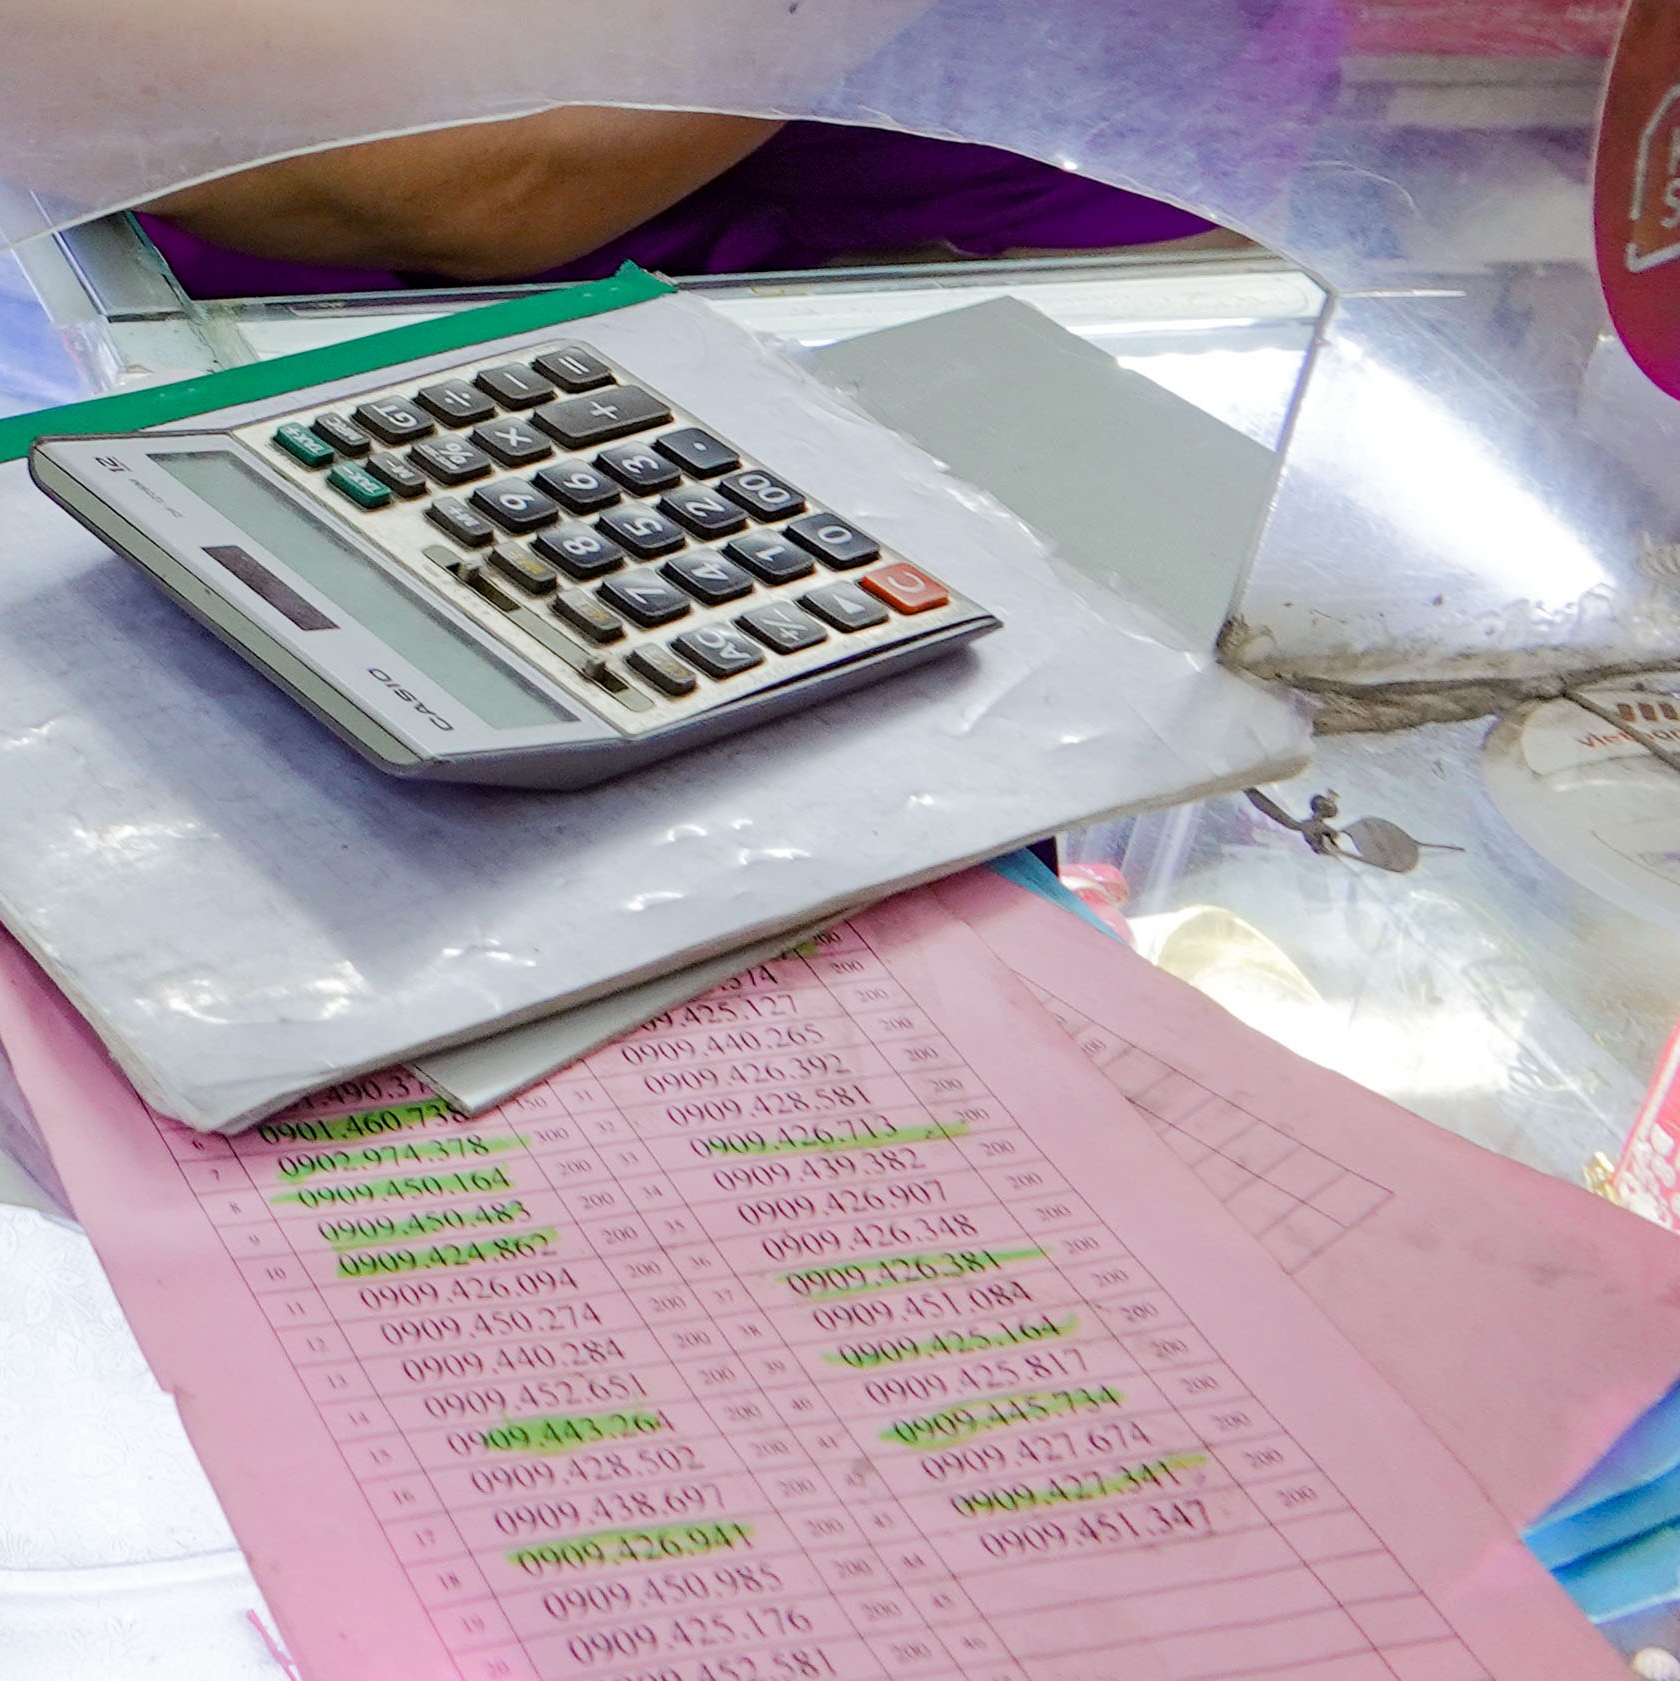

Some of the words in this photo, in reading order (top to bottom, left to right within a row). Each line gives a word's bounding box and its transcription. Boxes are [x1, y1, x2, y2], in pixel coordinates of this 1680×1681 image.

[368, 667, 454, 732] CASIO
[667, 1084, 872, 1127] 0909.428.581
[277, 1135, 490, 1179] 0902.974.378
[713, 1148, 927, 1192] 0909.439.382
[297, 1167, 511, 1208] 0909.450.164
[340, 1234, 556, 1276] 0909.424.862
[762, 1212, 978, 1261] 0909.426.348
[359, 1268, 579, 1311] 0909.426.094
[812, 1282, 1034, 1331] 0909.451.084
[402, 1338, 626, 1383] 0909.440.284
[865, 1349, 1087, 1406] 0909.425.817
[470, 1445, 705, 1495] 0909.428.502
[921, 1422, 1151, 1480] 0909.427.674
[981, 1499, 1213, 1558] 0909.451.347
[544, 1564, 783, 1620] 0909.450.985
